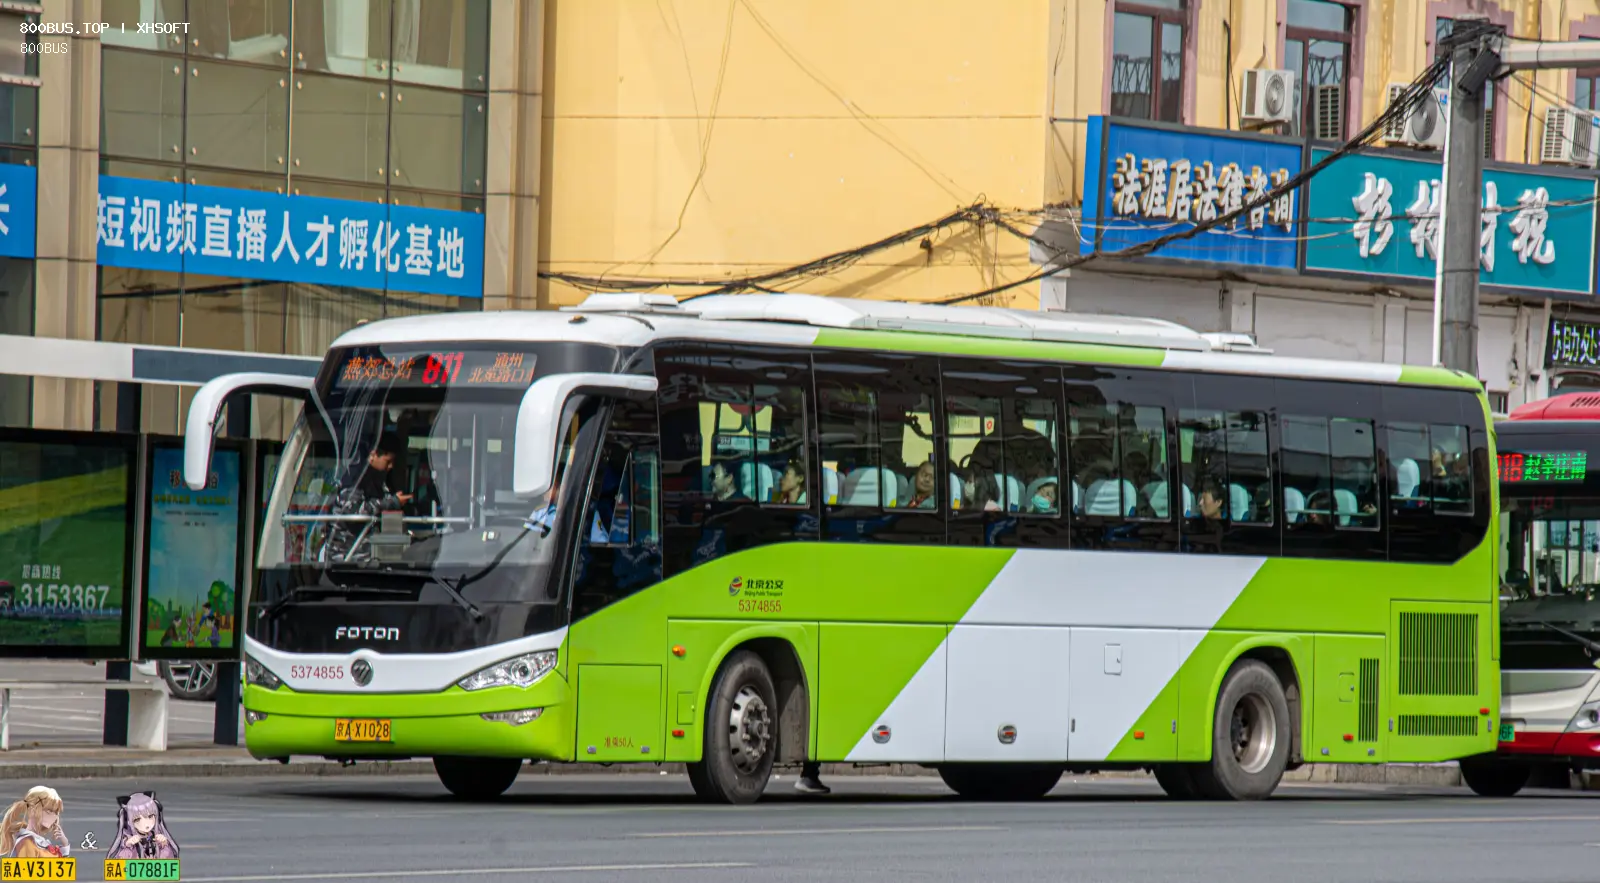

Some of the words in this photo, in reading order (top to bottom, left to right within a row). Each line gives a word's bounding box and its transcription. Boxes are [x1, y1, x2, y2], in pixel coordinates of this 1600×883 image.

[1112, 152, 1295, 234] 法涯居法律咨询
[97, 193, 465, 279] 短视频直播人才孵化基地
[343, 355, 415, 381] 燕郊总站
[421, 351, 465, 385] 811
[491, 352, 524, 370] 通州
[746, 578, 784, 590] 北京公交
[20, 583, 110, 614] 3153367
[738, 599, 782, 613] 5374855
[335, 626, 400, 641] FOTON
[290, 664, 345, 680] 5374855
